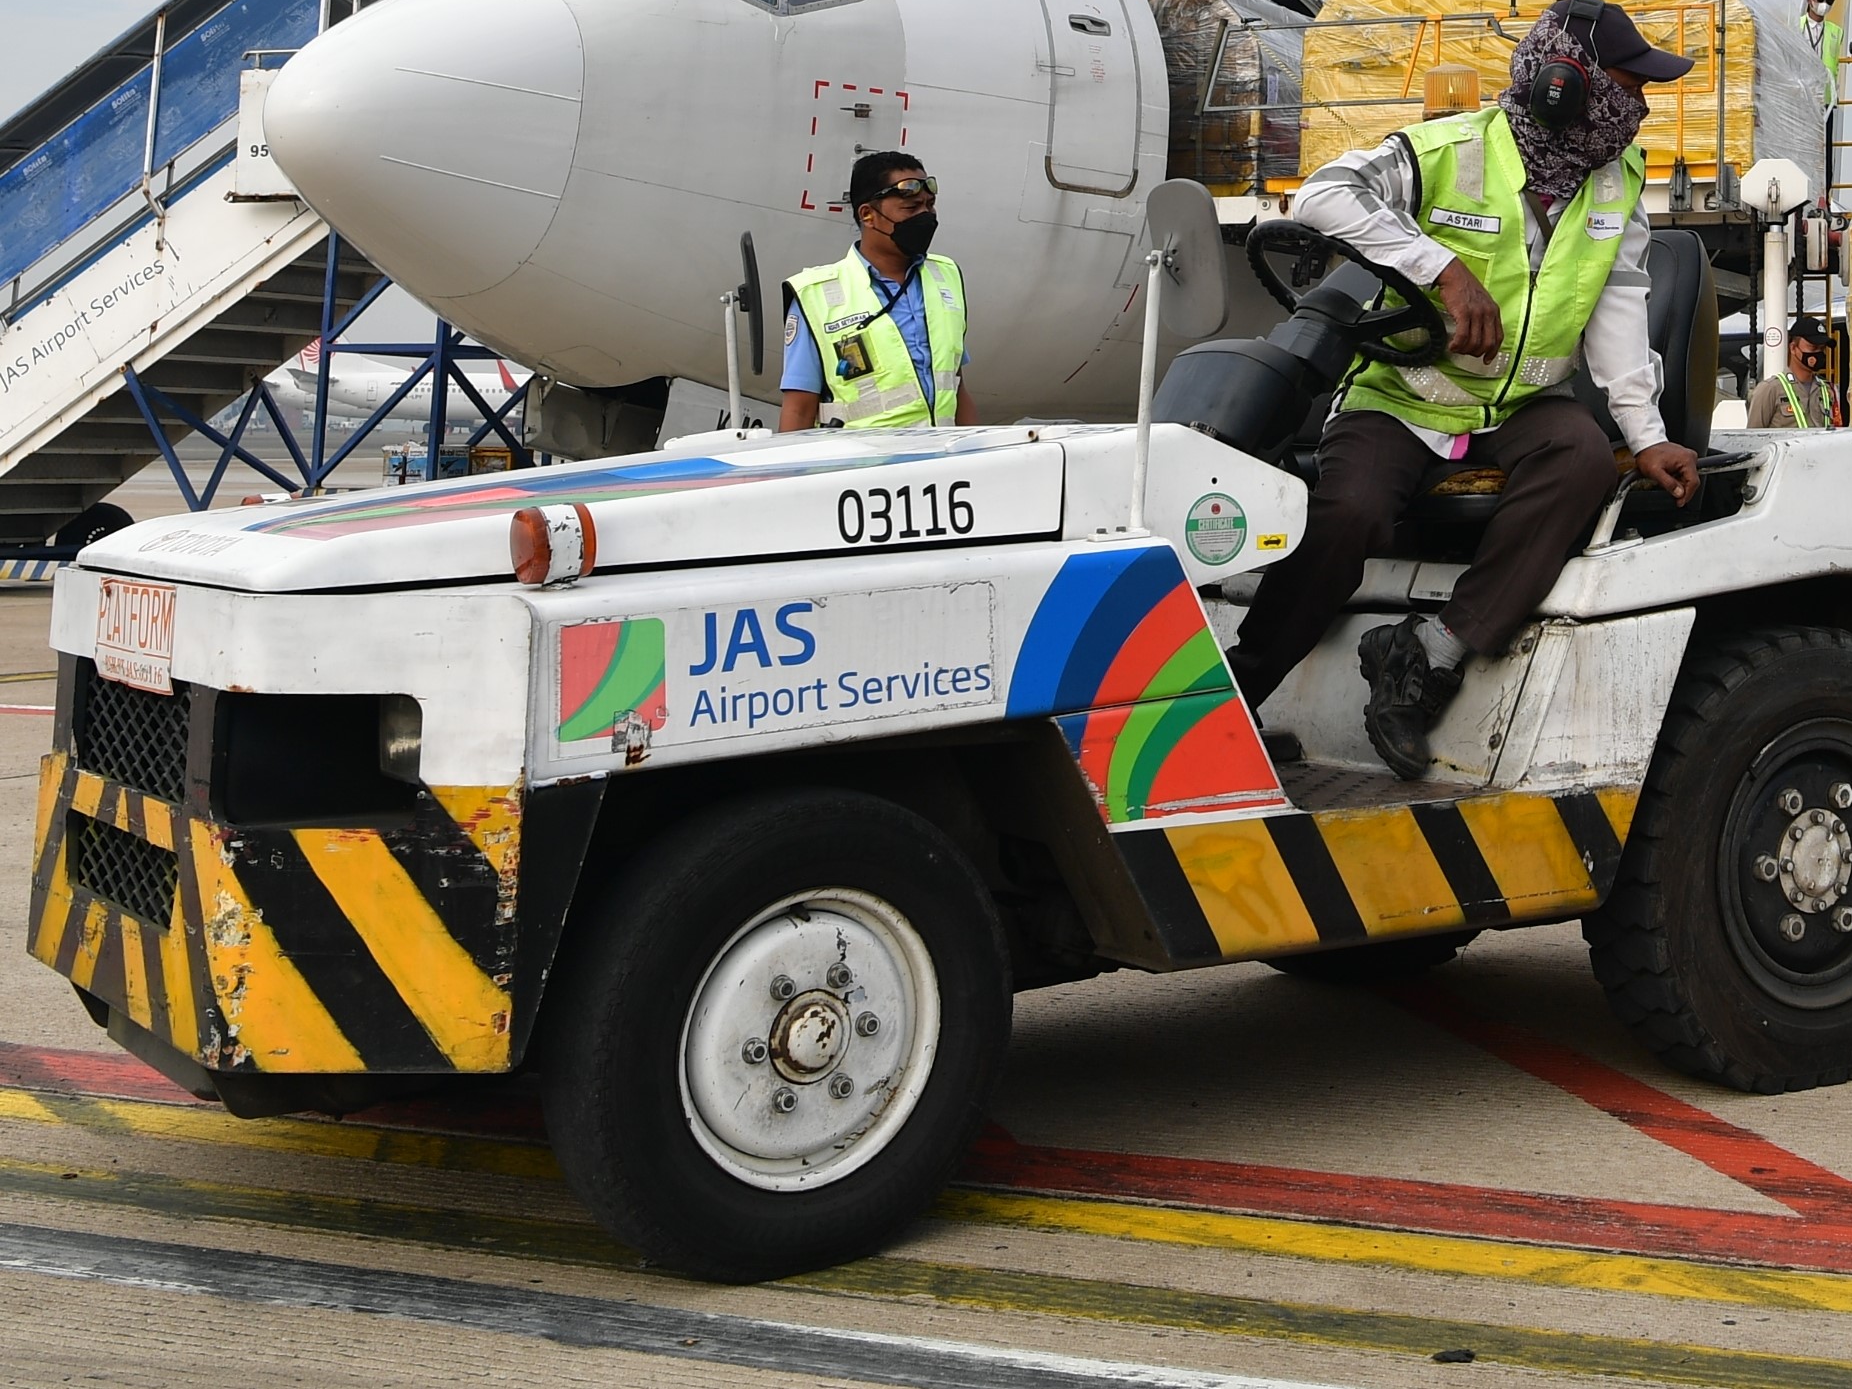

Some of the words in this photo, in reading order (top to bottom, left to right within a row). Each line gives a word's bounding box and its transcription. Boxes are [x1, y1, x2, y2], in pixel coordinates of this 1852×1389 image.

[1446, 215, 1483, 229] ASTARI
[0, 356, 30, 393] JAS
[31, 311, 92, 365] Airport
[90, 260, 165, 318] Services
[837, 481, 975, 544] 03116
[100, 585, 175, 653] PLATFORM
[689, 602, 817, 676] JAS
[689, 678, 828, 729] Airport
[838, 662, 991, 708] Services
